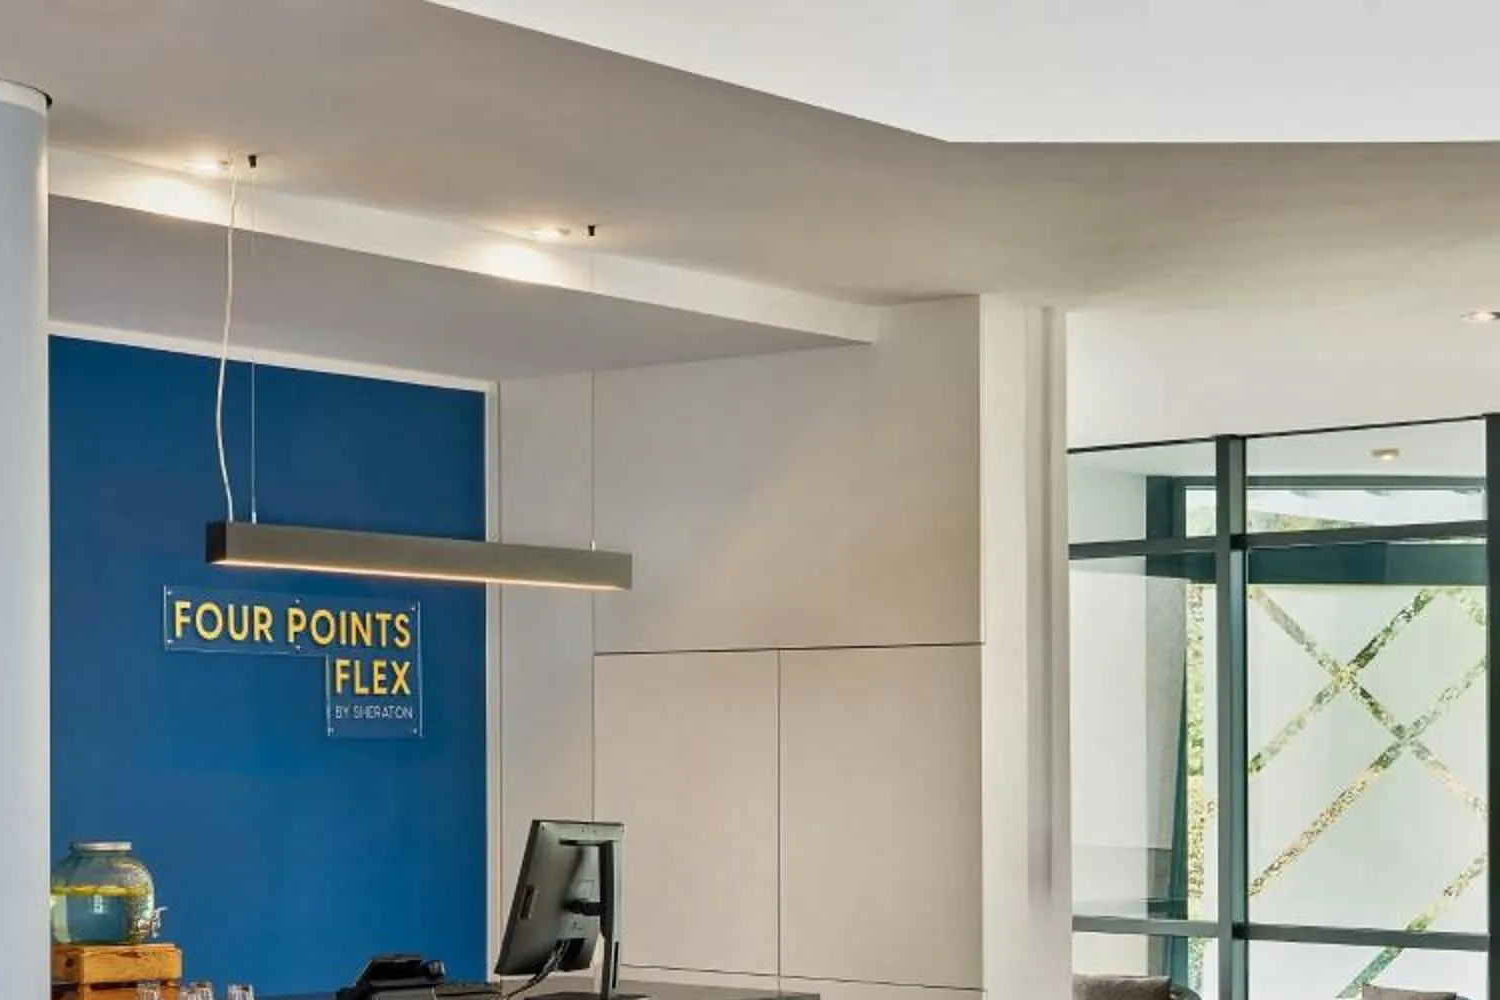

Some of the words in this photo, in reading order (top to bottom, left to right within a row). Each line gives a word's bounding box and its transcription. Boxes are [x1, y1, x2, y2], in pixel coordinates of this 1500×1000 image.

[174, 600, 274, 643] FOUR
[287, 607, 411, 648] POINTS
[335, 659, 411, 695] FLEX
[335, 705, 349, 719] BY
[353, 705, 413, 719] SHERATON
